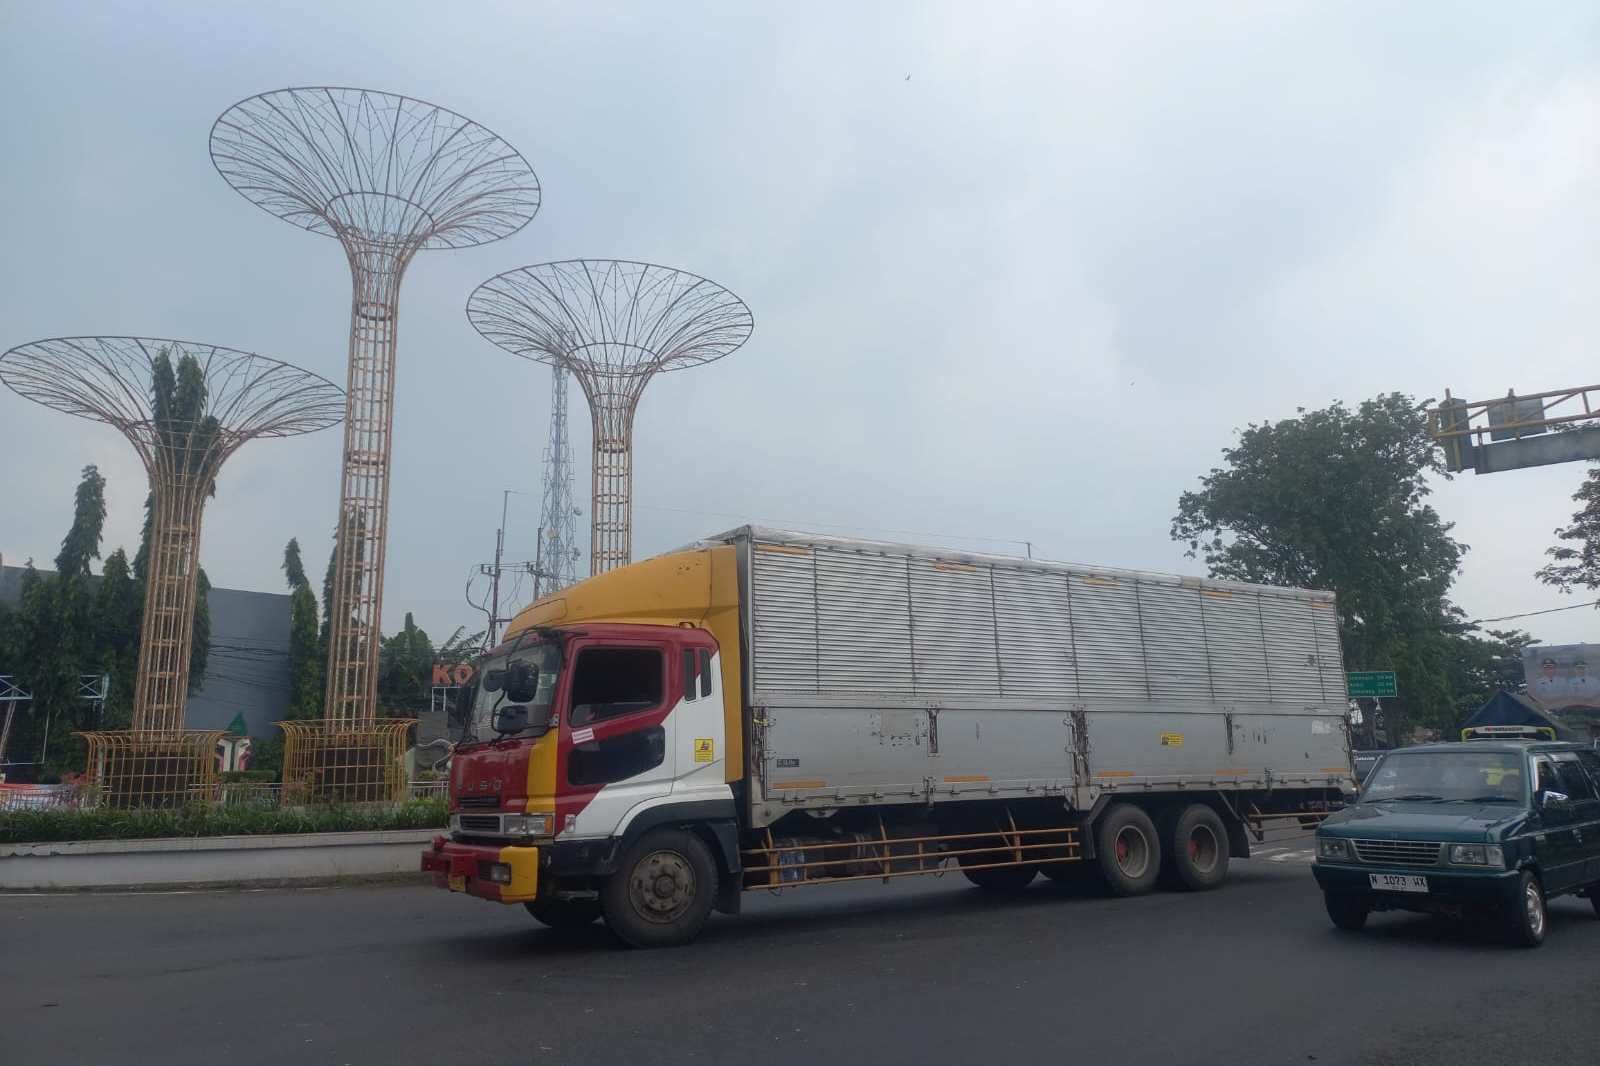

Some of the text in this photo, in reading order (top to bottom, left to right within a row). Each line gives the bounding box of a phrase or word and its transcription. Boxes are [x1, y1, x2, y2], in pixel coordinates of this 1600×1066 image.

[432, 663, 481, 686] KO
[457, 780, 502, 791] USO
[1370, 875, 1425, 886] N 1073 WX
